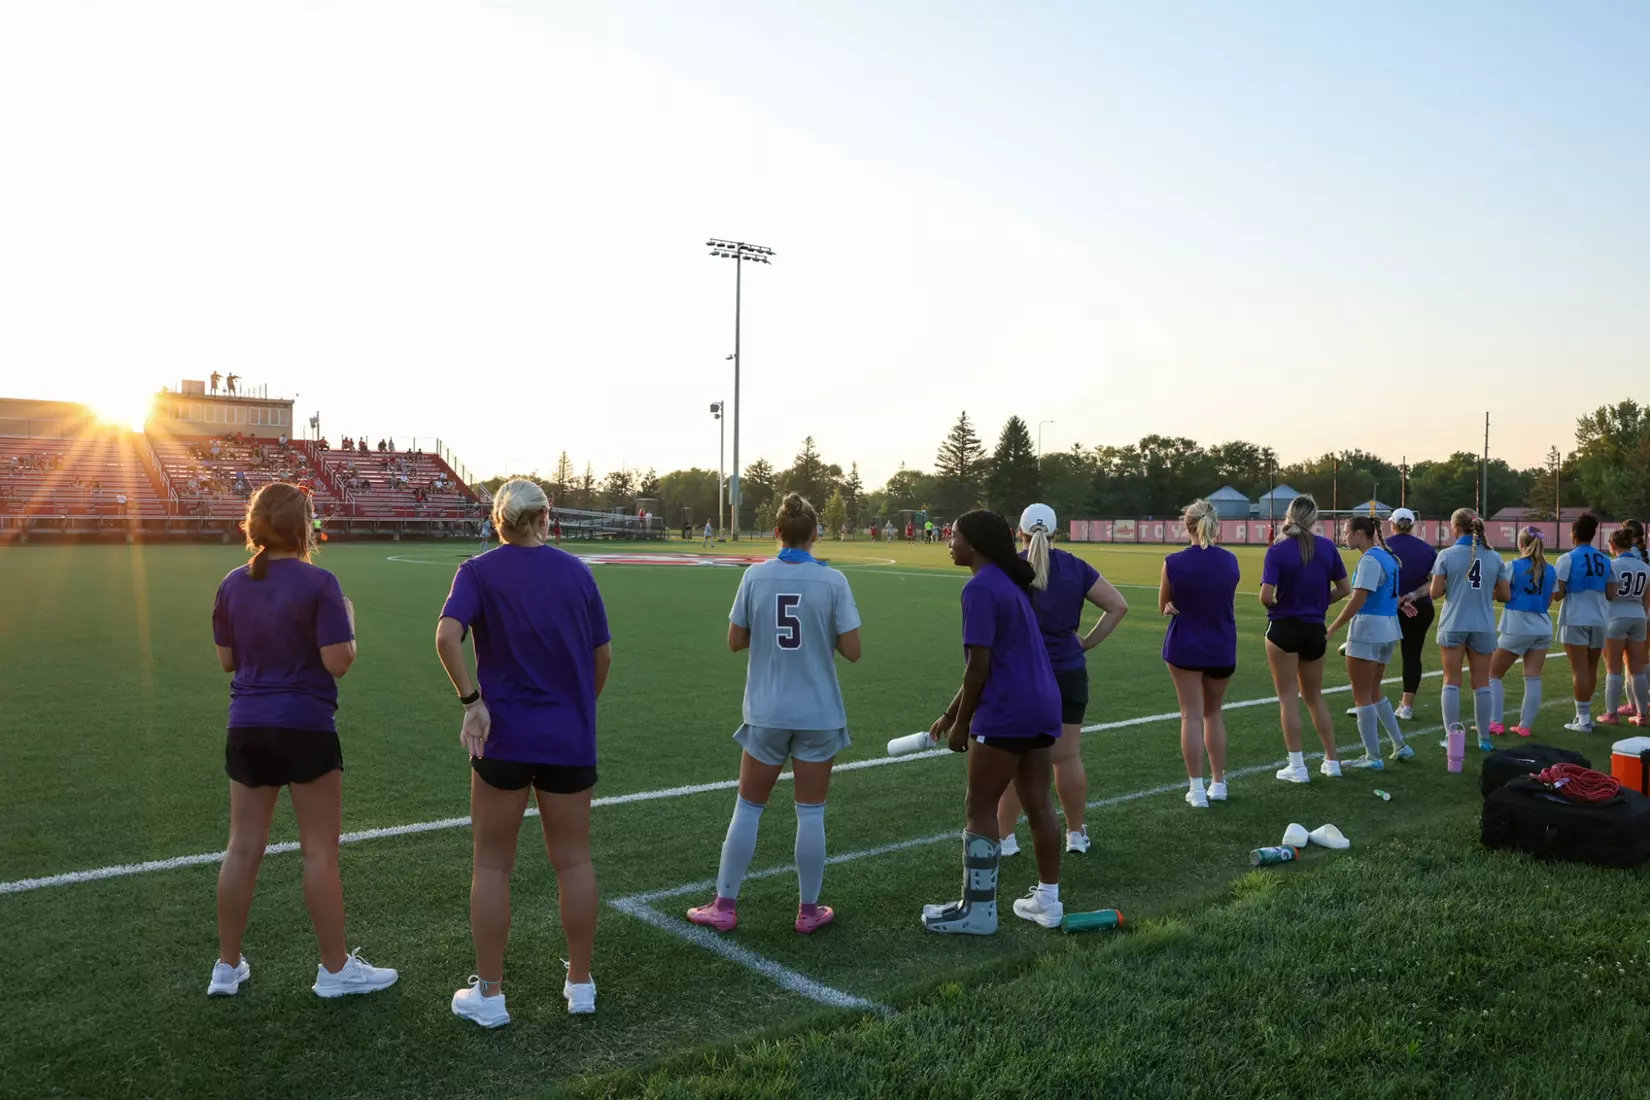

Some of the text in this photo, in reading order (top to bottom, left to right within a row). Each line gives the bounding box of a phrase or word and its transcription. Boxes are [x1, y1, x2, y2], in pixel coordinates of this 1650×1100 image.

[1467, 557, 1482, 590] 4
[1584, 552, 1604, 577] 16
[1617, 571, 1648, 597] 30
[775, 592, 803, 651] 5
